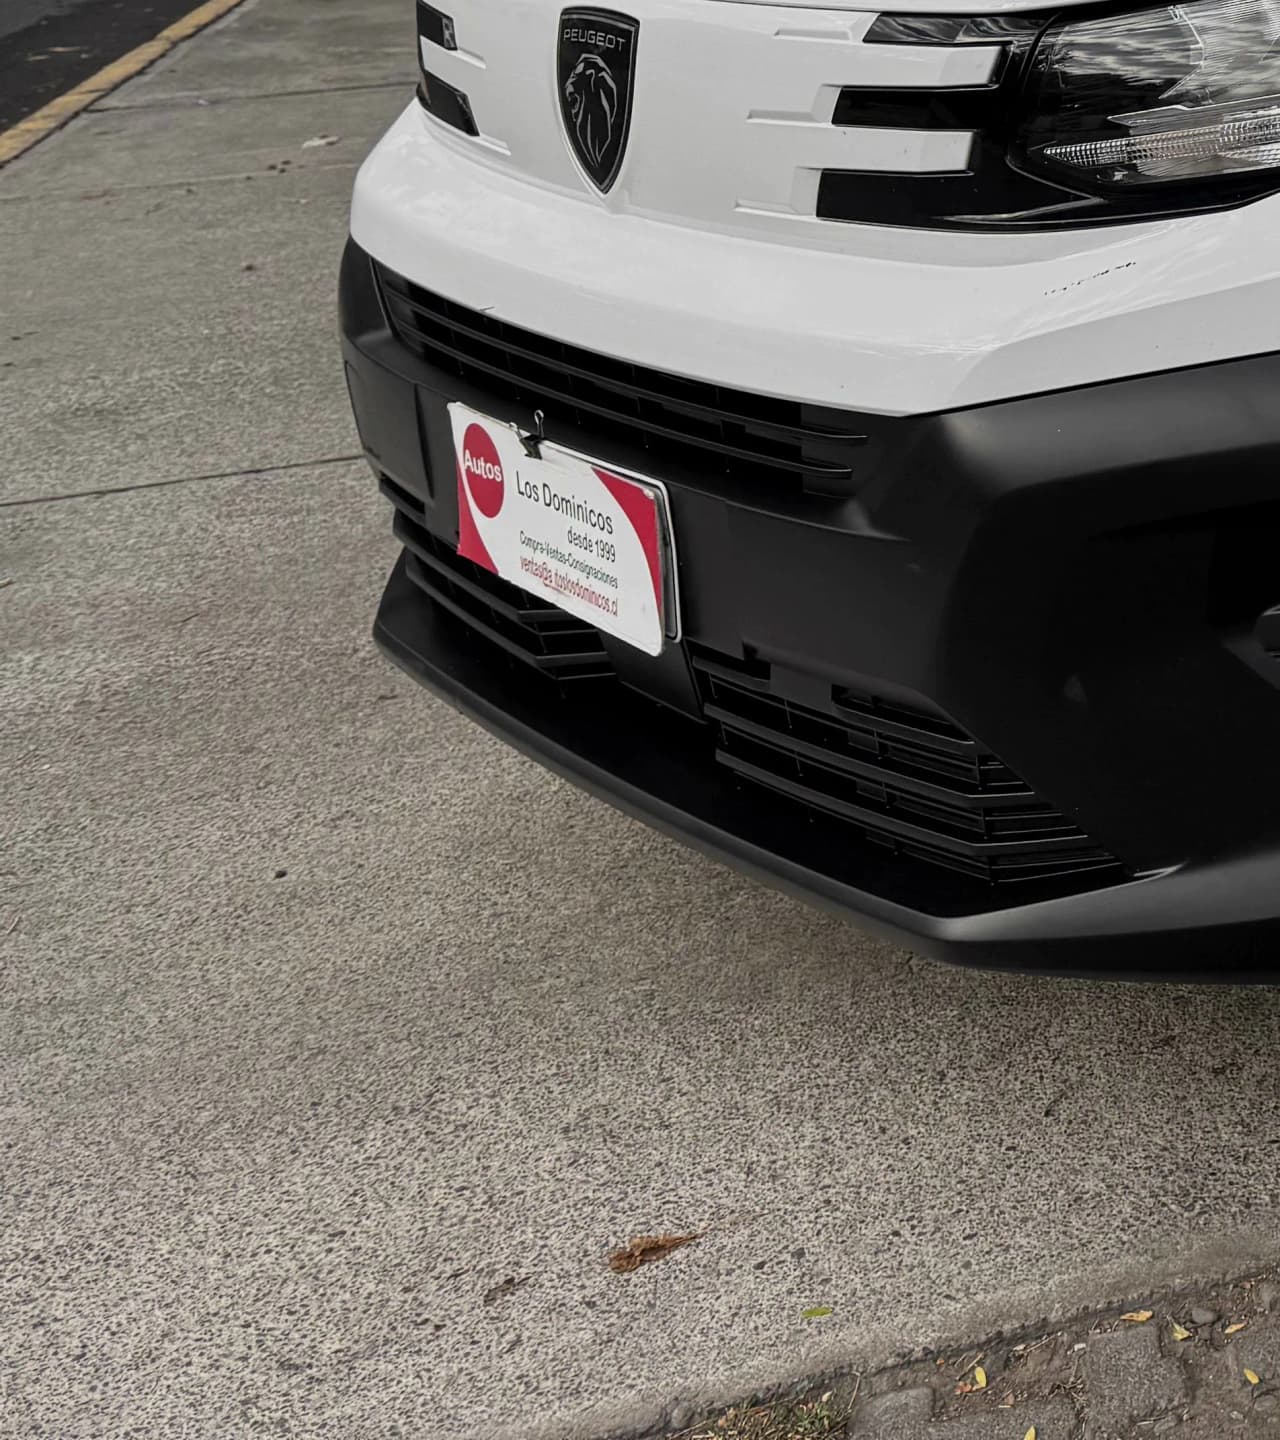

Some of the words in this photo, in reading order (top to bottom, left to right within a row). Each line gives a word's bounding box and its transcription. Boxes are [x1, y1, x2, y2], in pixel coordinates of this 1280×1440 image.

[563, 28, 627, 52] PEUGEOT
[463, 449, 502, 482] Autos
[516, 470, 539, 503] Los
[543, 483, 614, 535] Dominicos
[567, 525, 594, 554] desde
[595, 538, 616, 563] 1999
